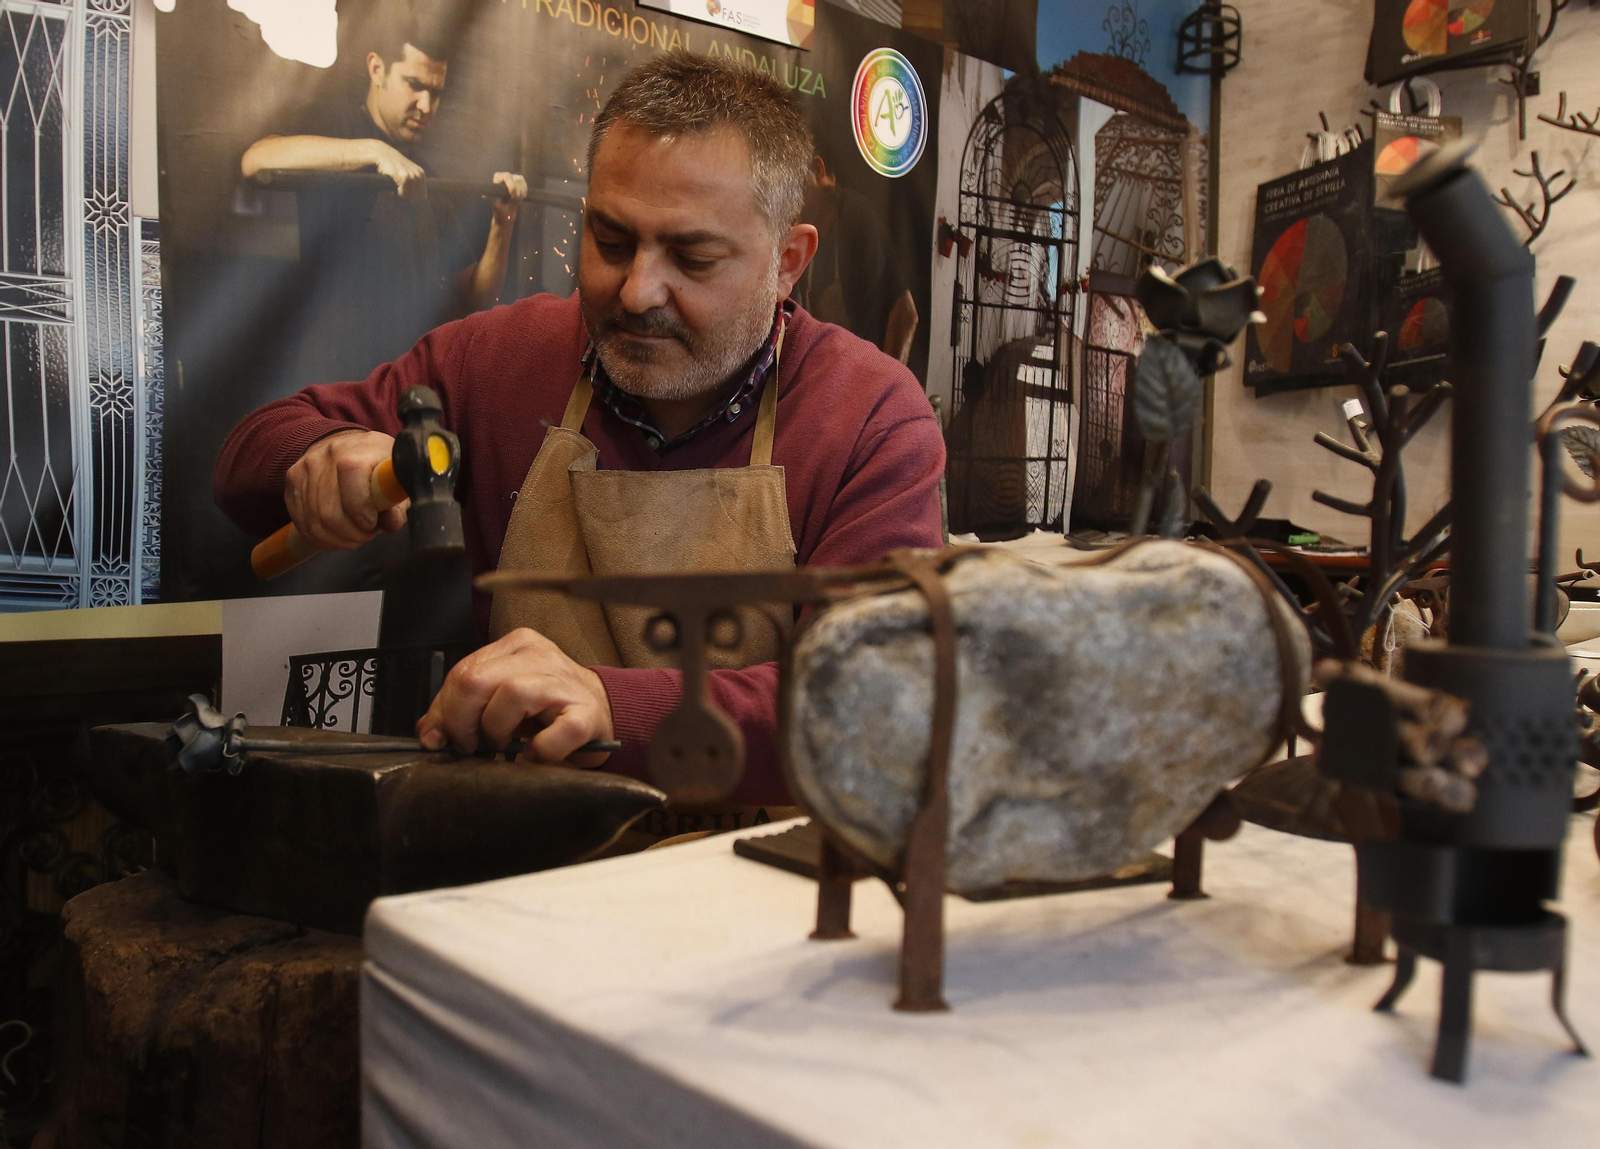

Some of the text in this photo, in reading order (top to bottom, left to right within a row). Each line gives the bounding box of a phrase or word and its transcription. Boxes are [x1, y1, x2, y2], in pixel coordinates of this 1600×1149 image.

[722, 7, 743, 25] FAS
[1264, 194, 1301, 215] CREATIVA
[1304, 189, 1314, 202] DE
[1316, 178, 1346, 197] SEVILLA
[1265, 186, 1286, 199] FERIA
[1287, 181, 1297, 194] DE
